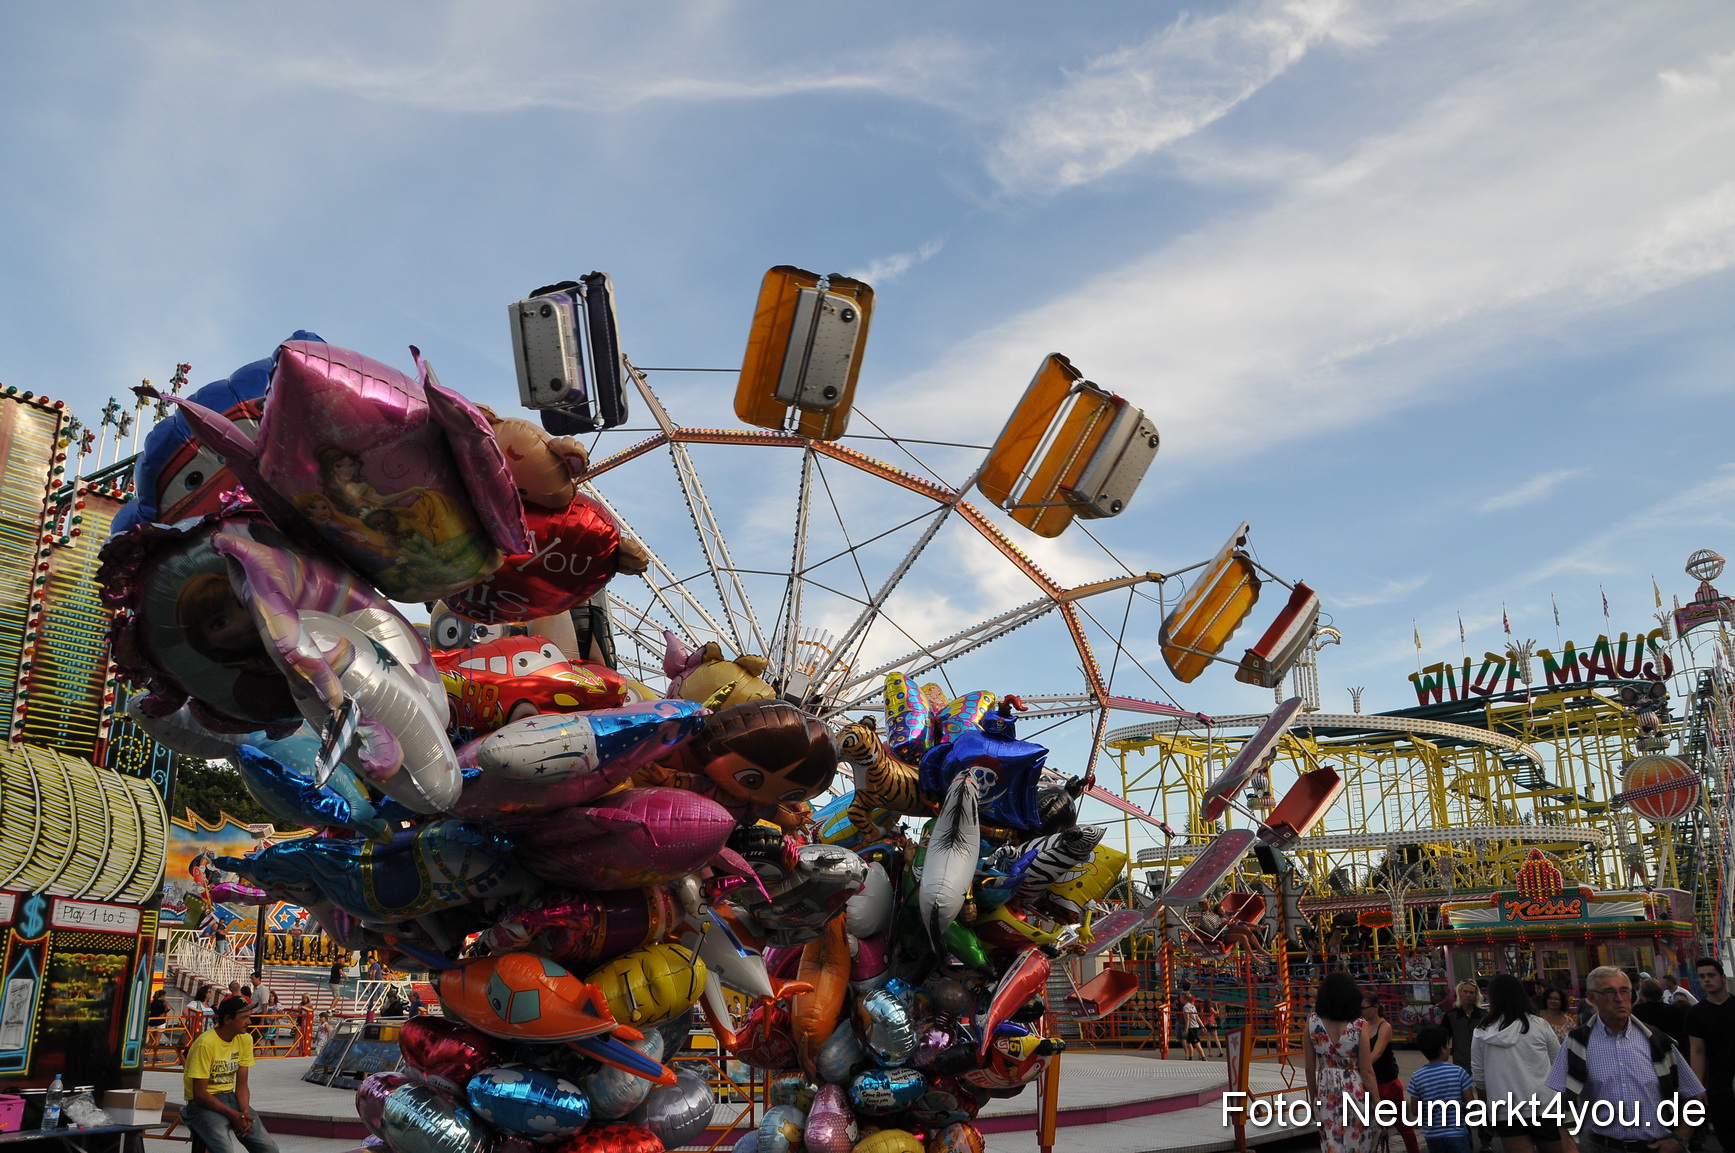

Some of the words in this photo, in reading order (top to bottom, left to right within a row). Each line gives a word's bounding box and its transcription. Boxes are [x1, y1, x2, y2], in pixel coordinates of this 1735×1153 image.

[1536, 628, 1673, 688] MAUS
[62, 905, 85, 923] Play
[89, 908, 98, 921] 1
[103, 909, 114, 923] to
[117, 912, 126, 924] 5
[1503, 899, 1583, 921] Kasse
